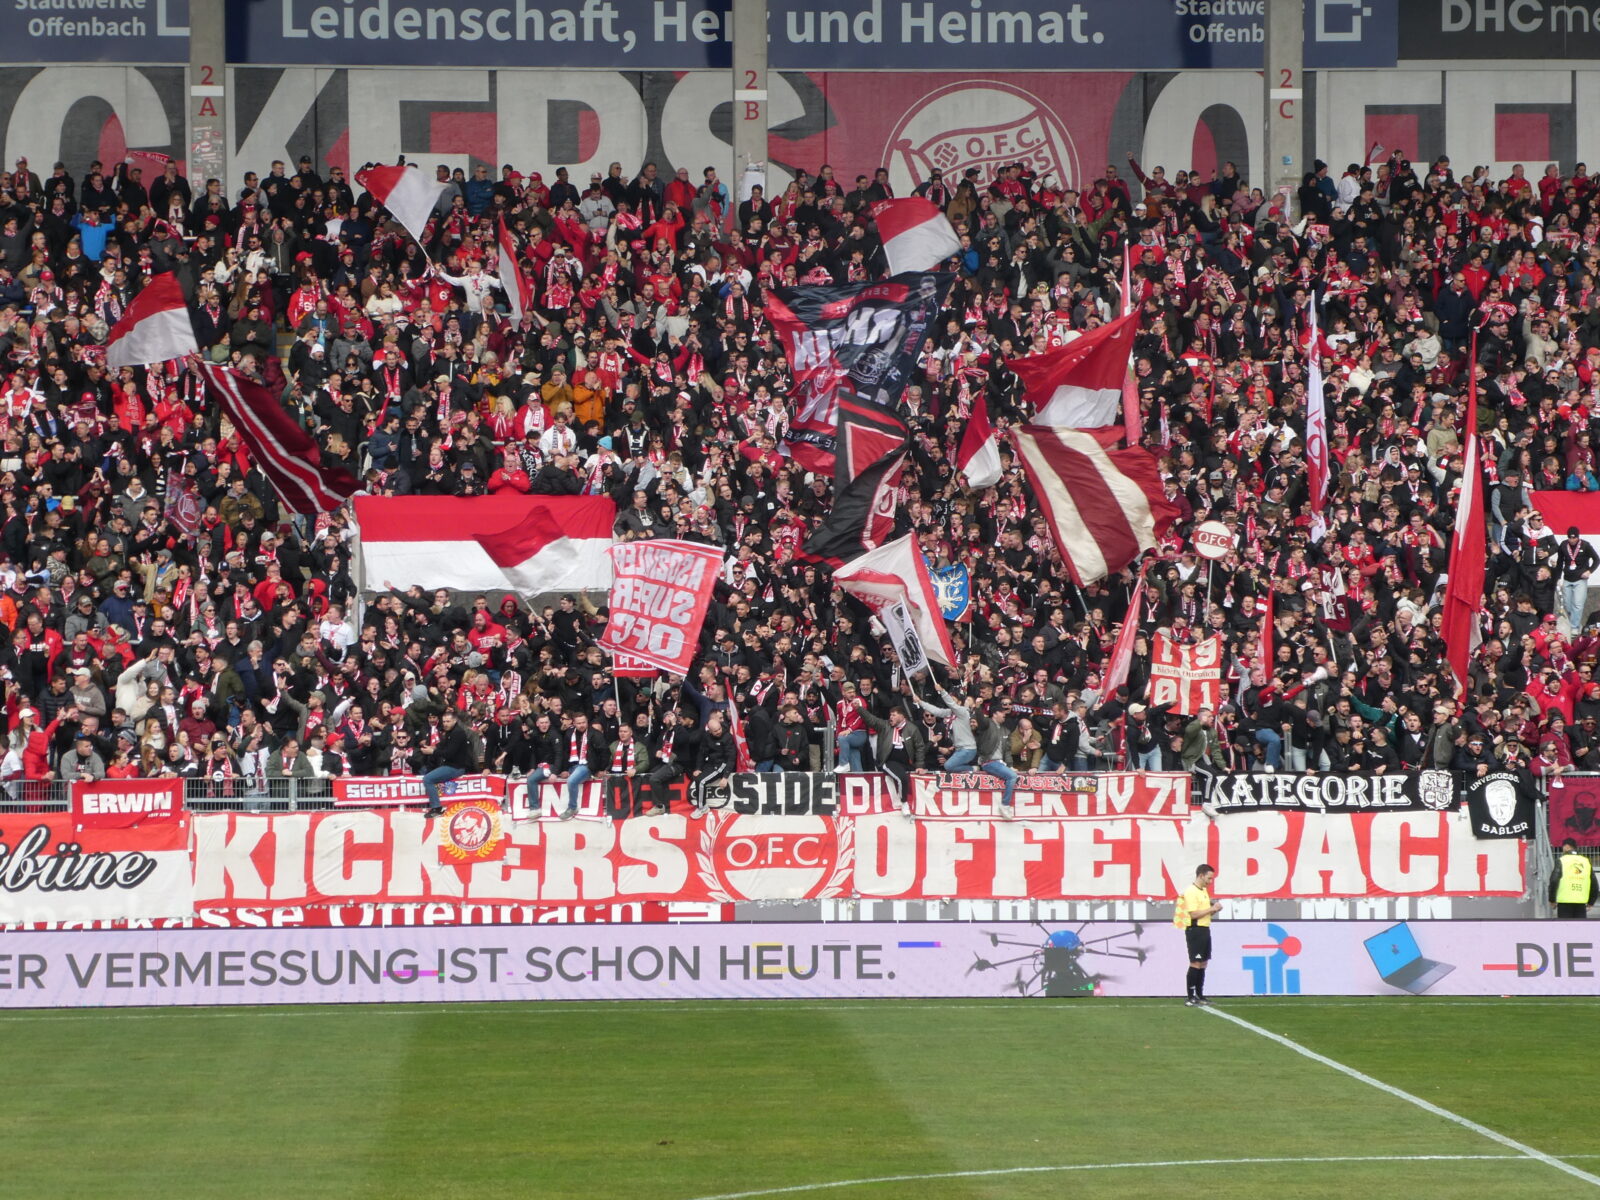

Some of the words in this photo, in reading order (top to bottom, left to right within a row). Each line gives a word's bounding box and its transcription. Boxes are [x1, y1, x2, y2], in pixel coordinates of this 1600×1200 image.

[28, 16, 146, 36] Offenbach
[282, 0, 636, 52] Leidenschaft,
[787, 0, 881, 43] und
[902, 0, 1105, 44] Heimat.
[200, 66, 214, 85] 2
[744, 71, 758, 89] 2
[1280, 69, 1293, 88] 2
[199, 97, 217, 116] A
[744, 102, 759, 120] B
[1279, 100, 1294, 118] C
[965, 127, 1041, 158] O.F.C.
[1198, 532, 1229, 548] O.F.C.
[940, 772, 1072, 792] LEVERUSEN
[1213, 774, 1412, 808] KATEGORIE
[82, 791, 172, 814] ERWIN
[733, 773, 836, 815] SIDE
[1146, 777, 1188, 816] 71
[196, 811, 689, 900] KICKERS
[726, 837, 829, 867] O.F.C.
[854, 812, 1524, 897] OFFENBACH
[66, 949, 419, 989] VERMESSUNG
[438, 947, 508, 984] IST
[525, 946, 701, 984] SCHON
[719, 944, 896, 981] HEUTE.
[1516, 943, 1595, 978] DIE
